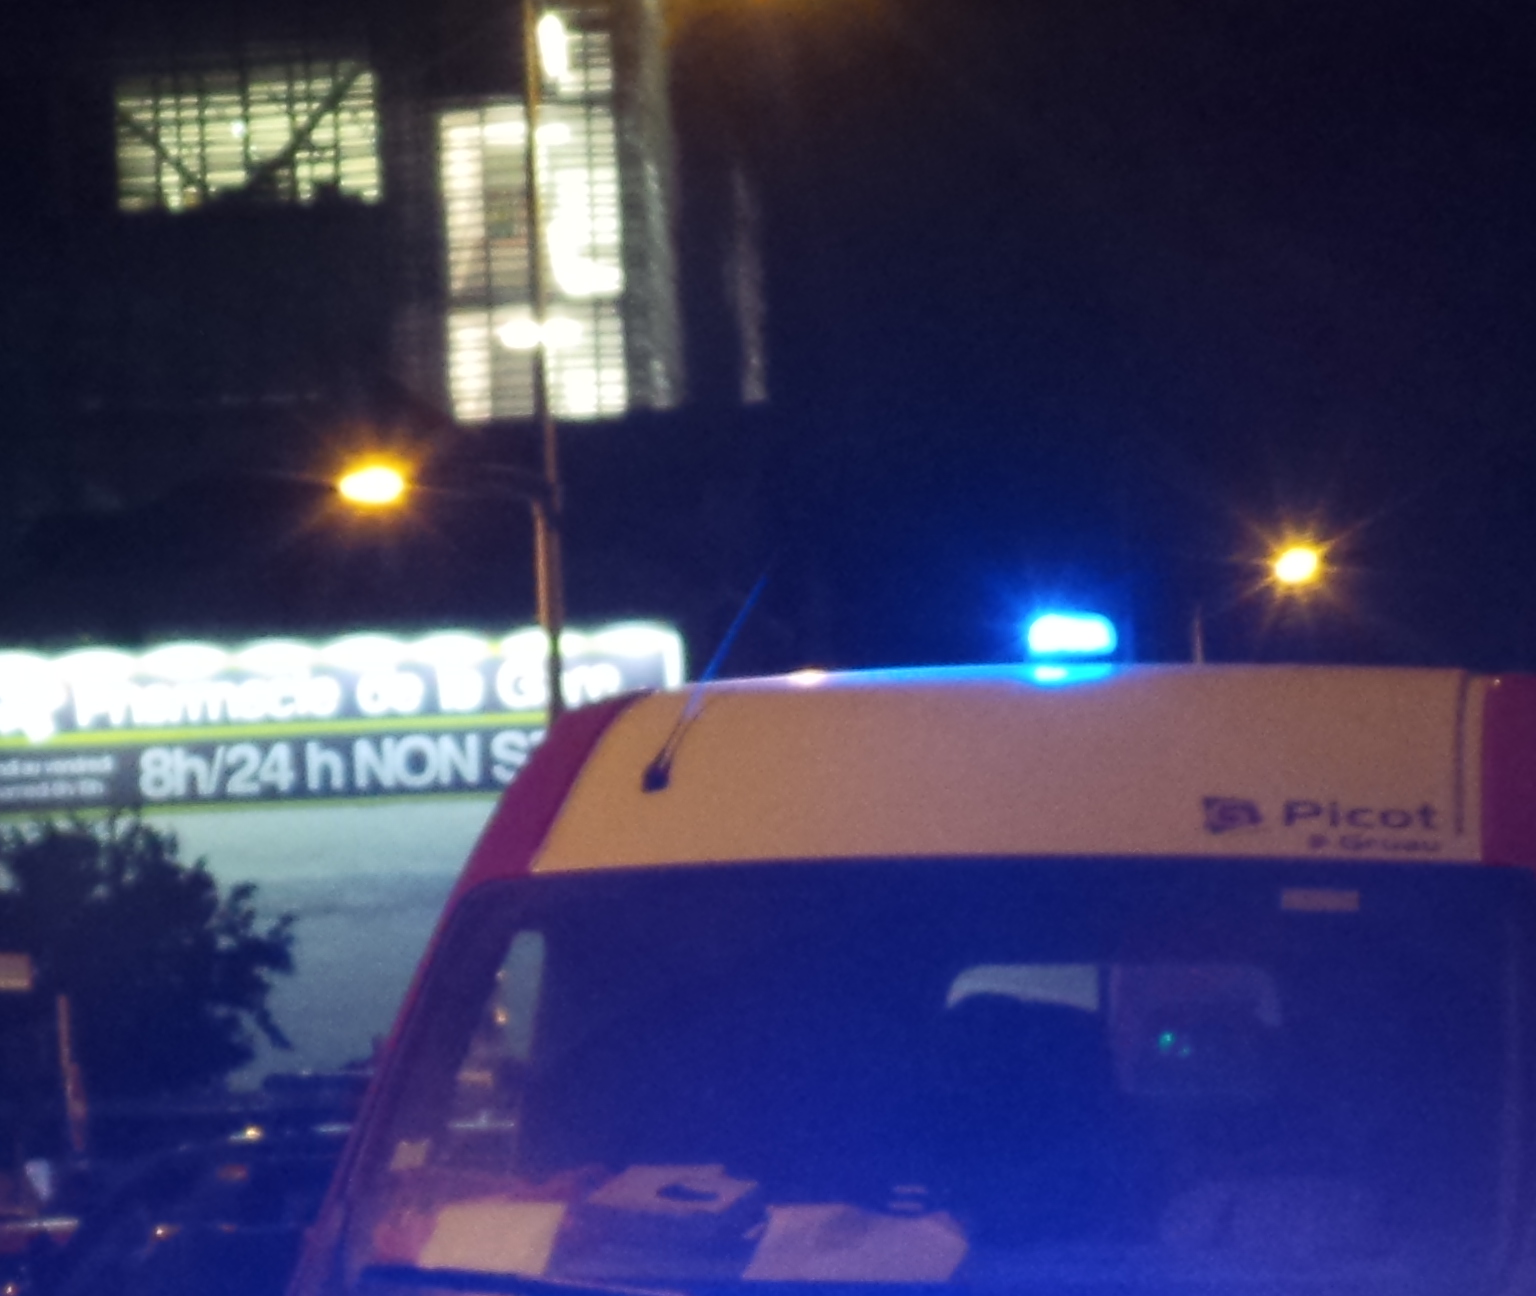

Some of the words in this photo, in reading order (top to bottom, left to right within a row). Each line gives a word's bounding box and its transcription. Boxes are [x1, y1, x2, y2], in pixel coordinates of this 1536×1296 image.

[139, 742, 294, 799] 8h/24
[353, 732, 480, 789] NON
[490, 729, 546, 784] S
[1283, 800, 1436, 830] Picot
